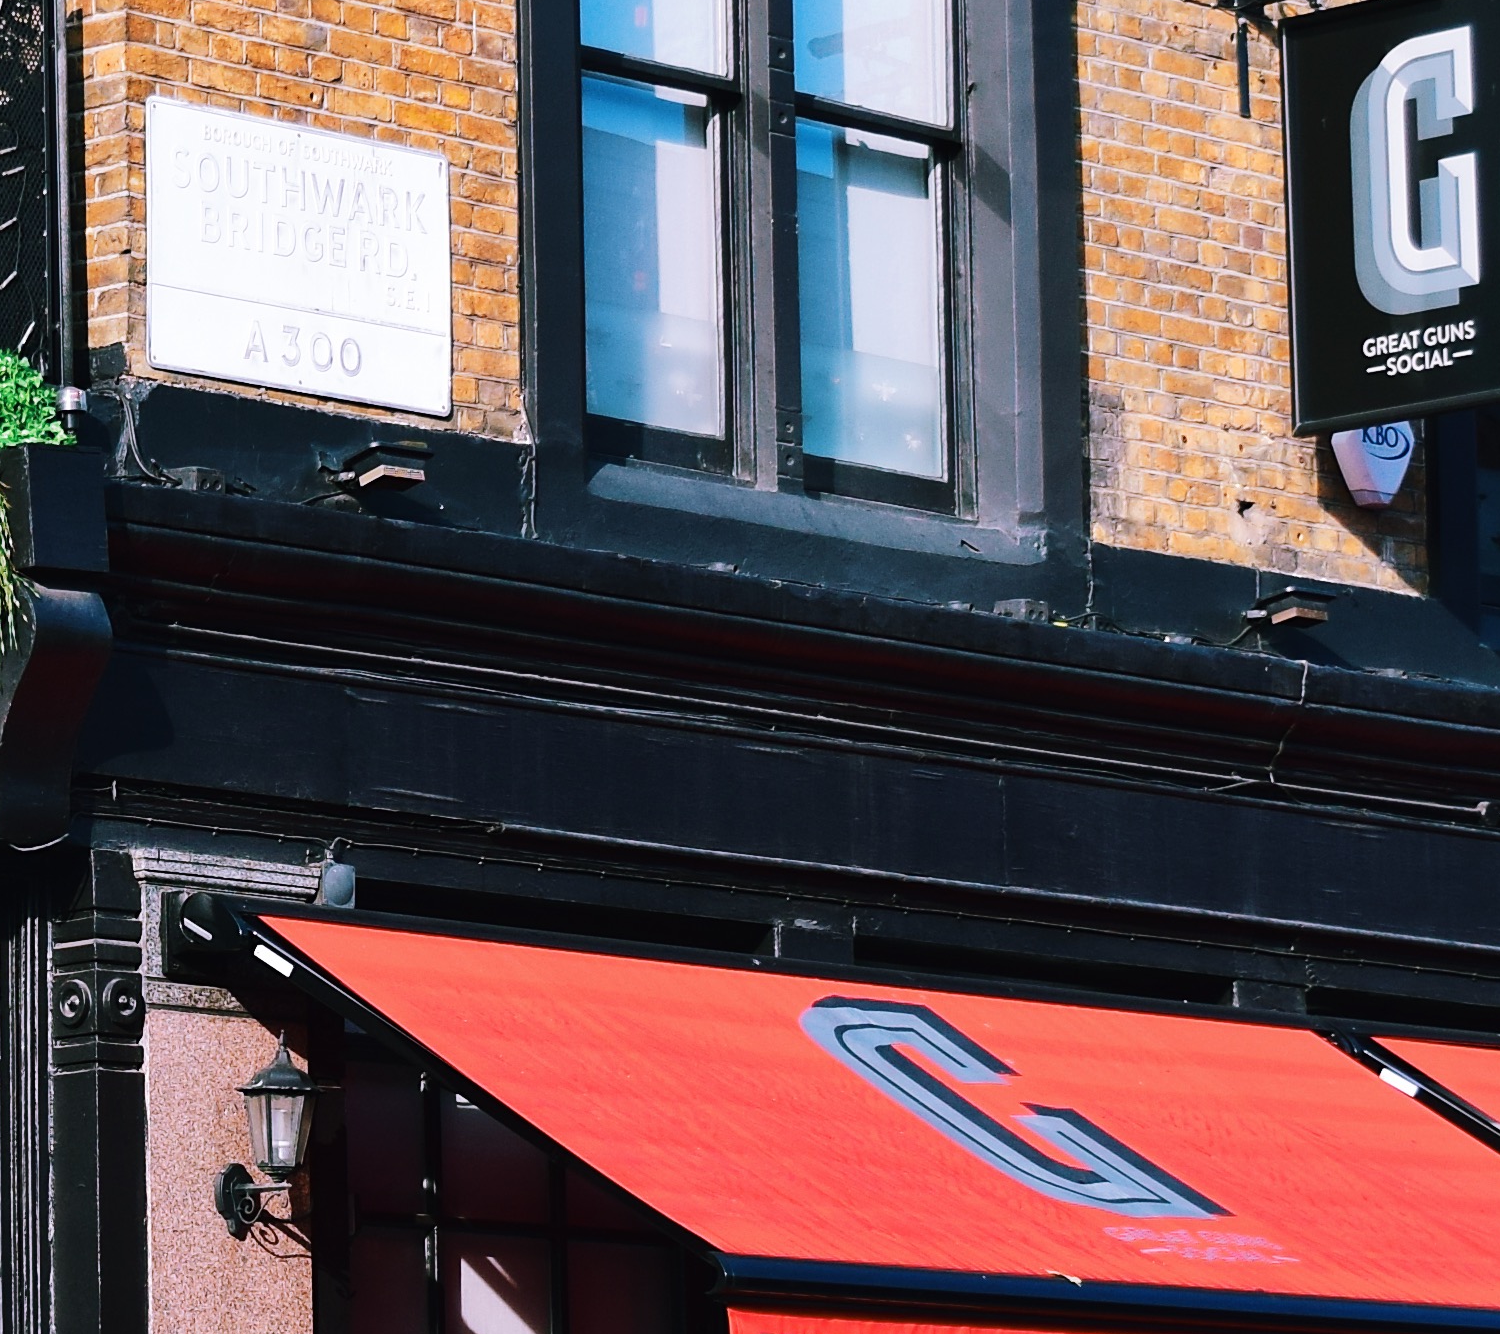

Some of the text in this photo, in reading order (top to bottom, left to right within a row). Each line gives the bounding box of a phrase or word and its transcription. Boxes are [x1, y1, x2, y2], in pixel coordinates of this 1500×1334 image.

[202, 124, 272, 153] BOROUGH
[278, 139, 296, 156] OF
[170, 145, 428, 234] SOUTHWARK
[200, 200, 347, 268] BRIDGE
[1362, 319, 1476, 358] GREAT GUNS
[1385, 345, 1454, 377] SOCIAL
[1362, 425, 1399, 448] KBO
